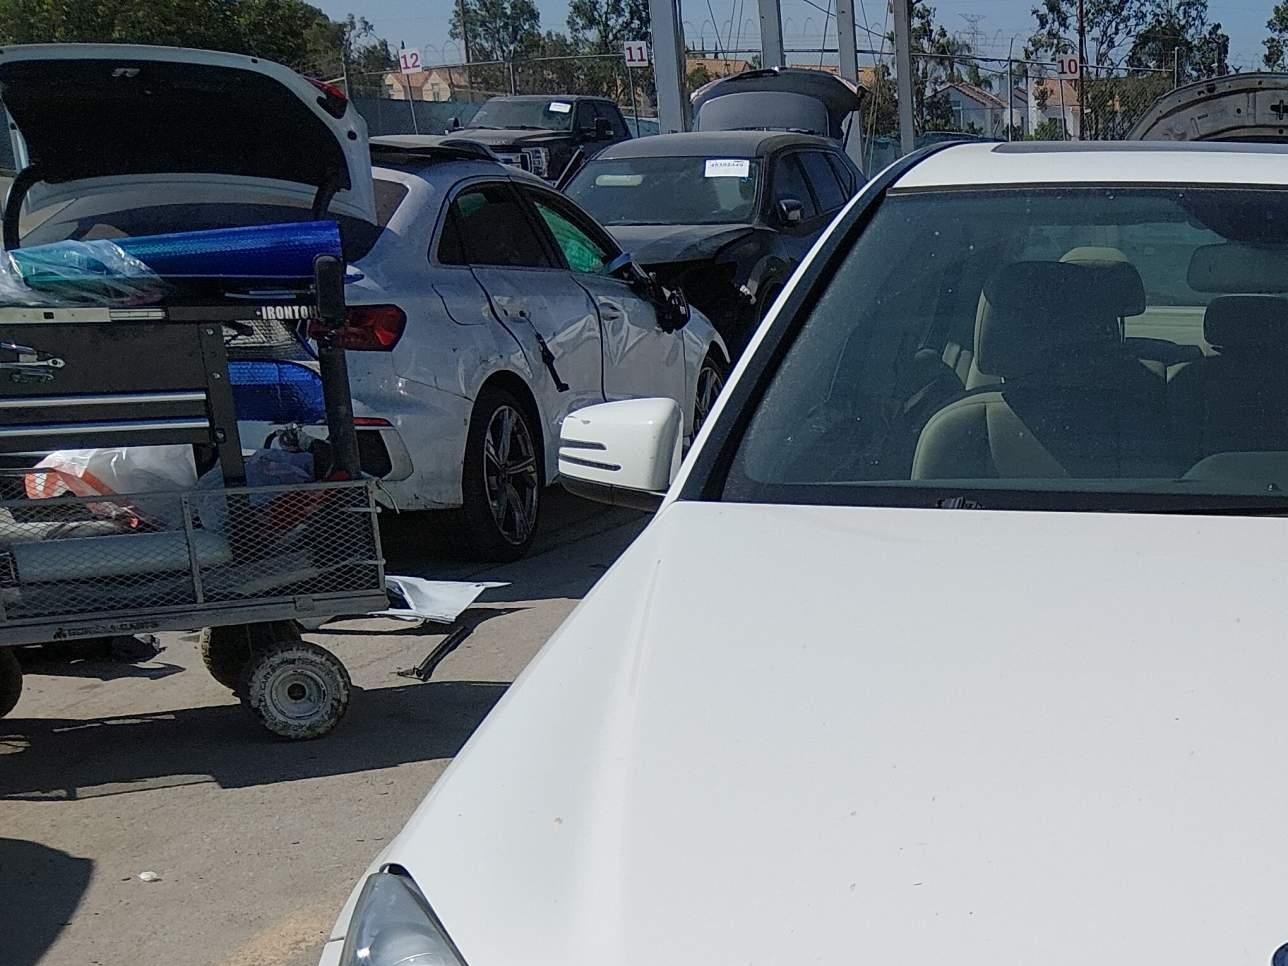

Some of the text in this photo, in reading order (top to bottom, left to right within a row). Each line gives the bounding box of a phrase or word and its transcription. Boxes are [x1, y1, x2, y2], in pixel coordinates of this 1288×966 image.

[401, 53, 420, 69] 12
[626, 46, 647, 61] 11
[1057, 59, 1078, 74] 10
